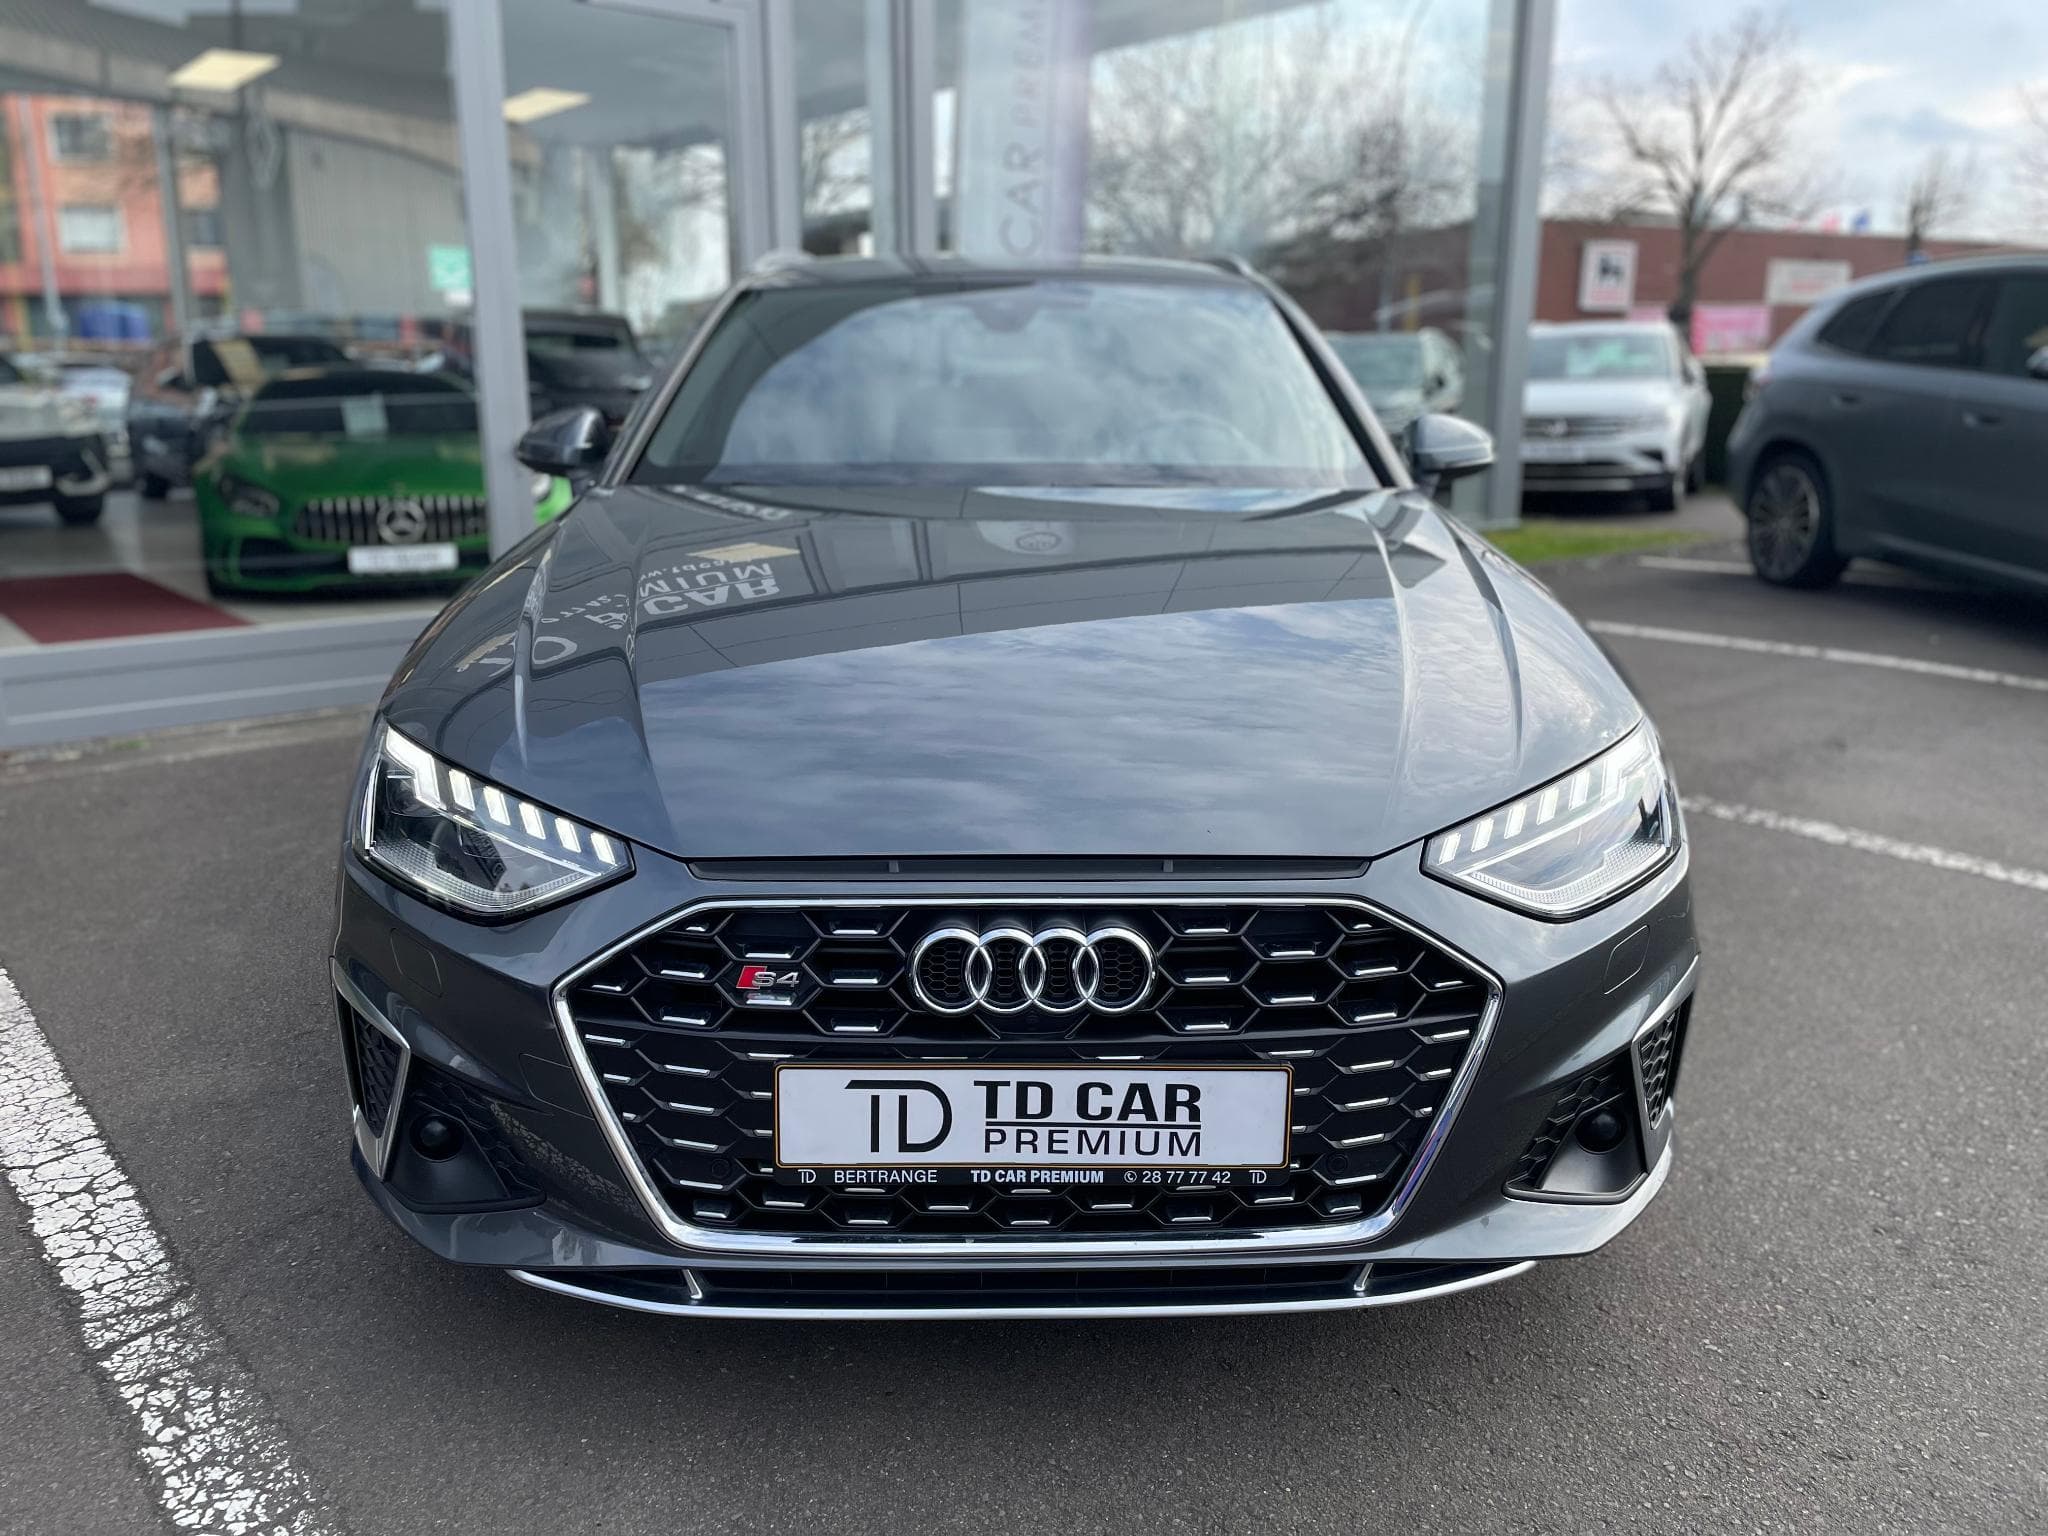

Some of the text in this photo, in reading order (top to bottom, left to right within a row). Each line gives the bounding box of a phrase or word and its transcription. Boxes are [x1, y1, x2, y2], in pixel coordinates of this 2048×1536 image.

[999, 141, 1046, 257] CAR
[751, 970, 800, 988] S4
[973, 1080, 1202, 1123] TD CAR
[844, 1079, 953, 1153] TD
[984, 1128, 1202, 1157] PREMIUM
[834, 1169, 938, 1184] BERTRANGE
[970, 1169, 1104, 1184] TD CAR PREMIUM
[1142, 1171, 1231, 1184] 28 77 77 42
